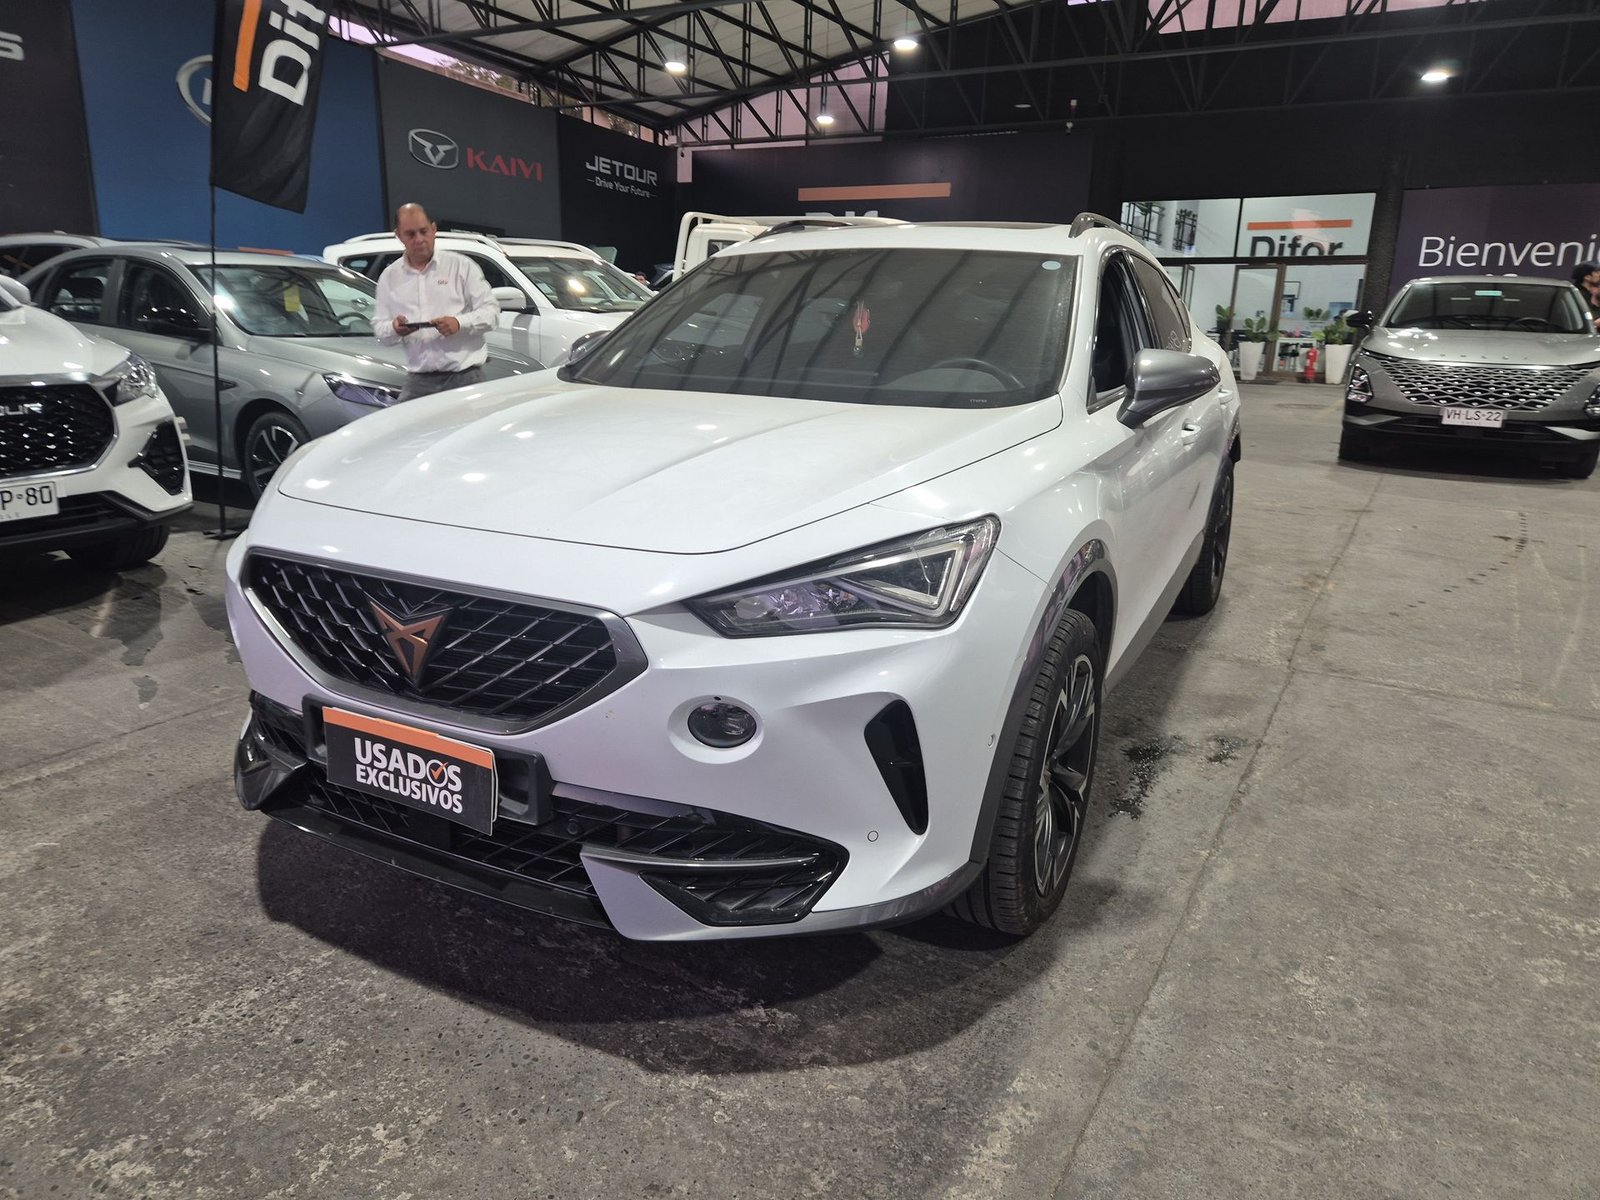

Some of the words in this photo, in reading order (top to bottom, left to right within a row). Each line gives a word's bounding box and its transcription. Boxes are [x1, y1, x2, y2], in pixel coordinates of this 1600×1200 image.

[585, 155, 658, 187] JETOUR
[595, 176, 614, 190] Drive
[613, 181, 630, 194] Your
[630, 185, 650, 198] Future
[1249, 234, 1344, 257] Difor
[1418, 233, 1600, 268] Bienveni
[354, 737, 463, 793] USADOS
[356, 764, 464, 814] EXCLUSIVOS
